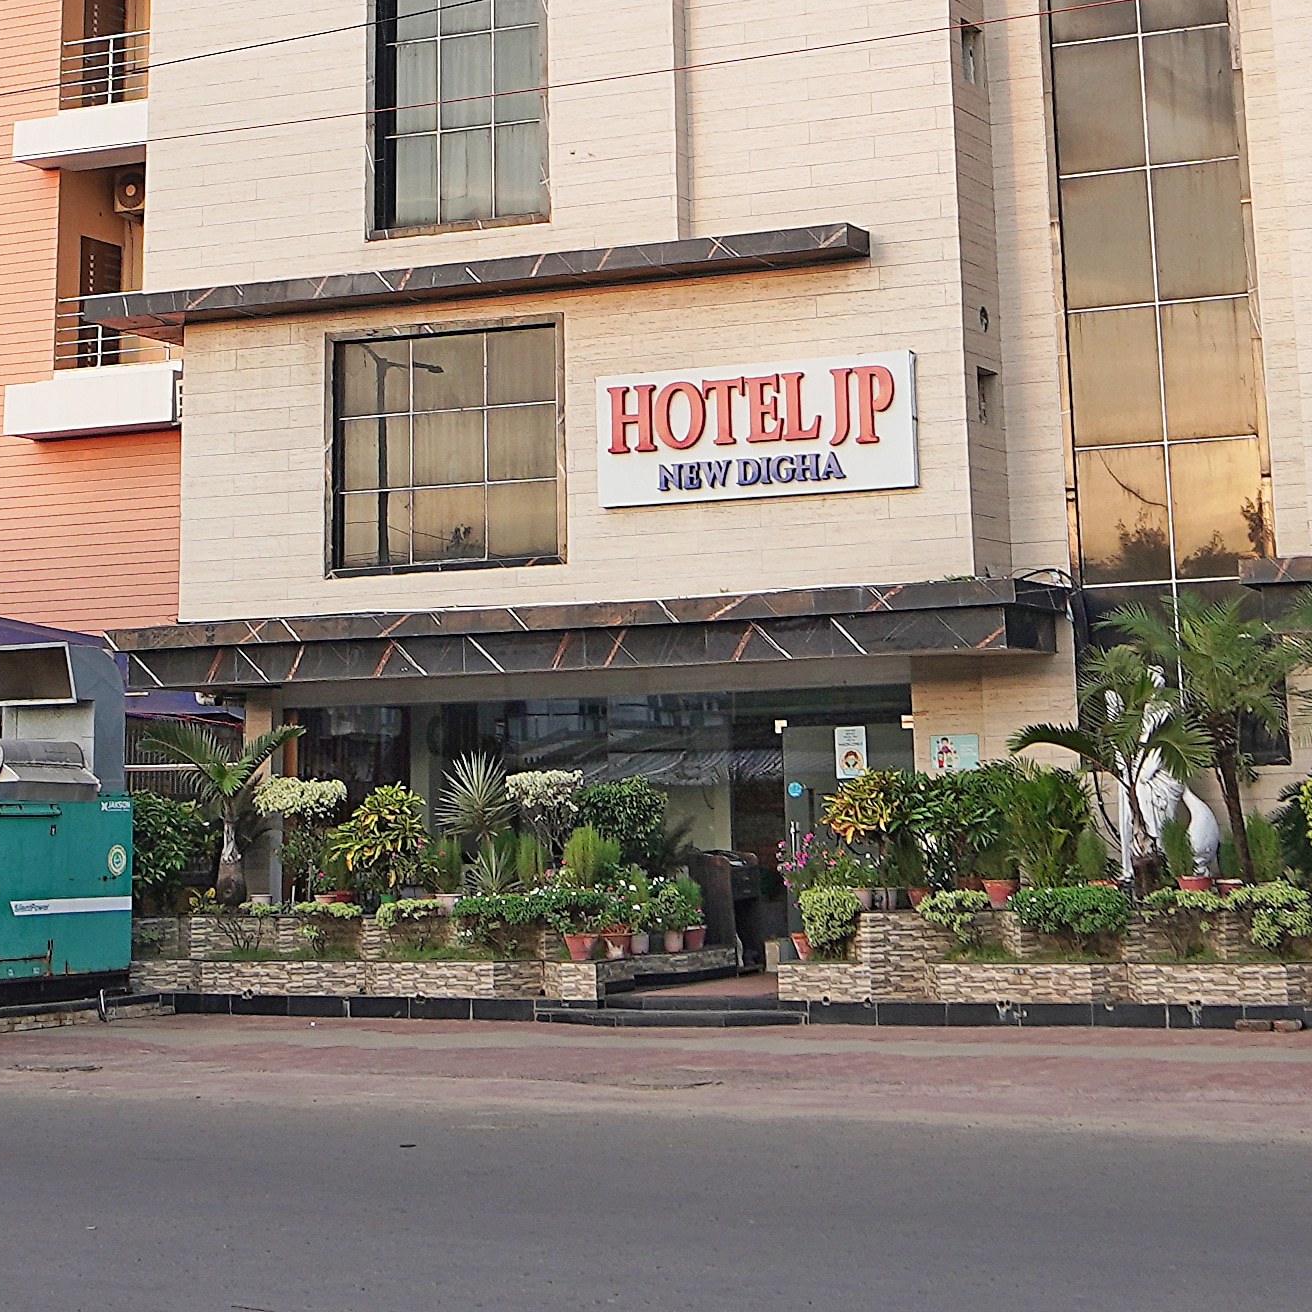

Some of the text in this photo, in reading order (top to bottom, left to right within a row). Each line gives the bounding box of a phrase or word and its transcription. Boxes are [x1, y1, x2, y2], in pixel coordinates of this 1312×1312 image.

[606, 365, 896, 455] HOTEL JP
[657, 451, 846, 492] NEW DIGHA
